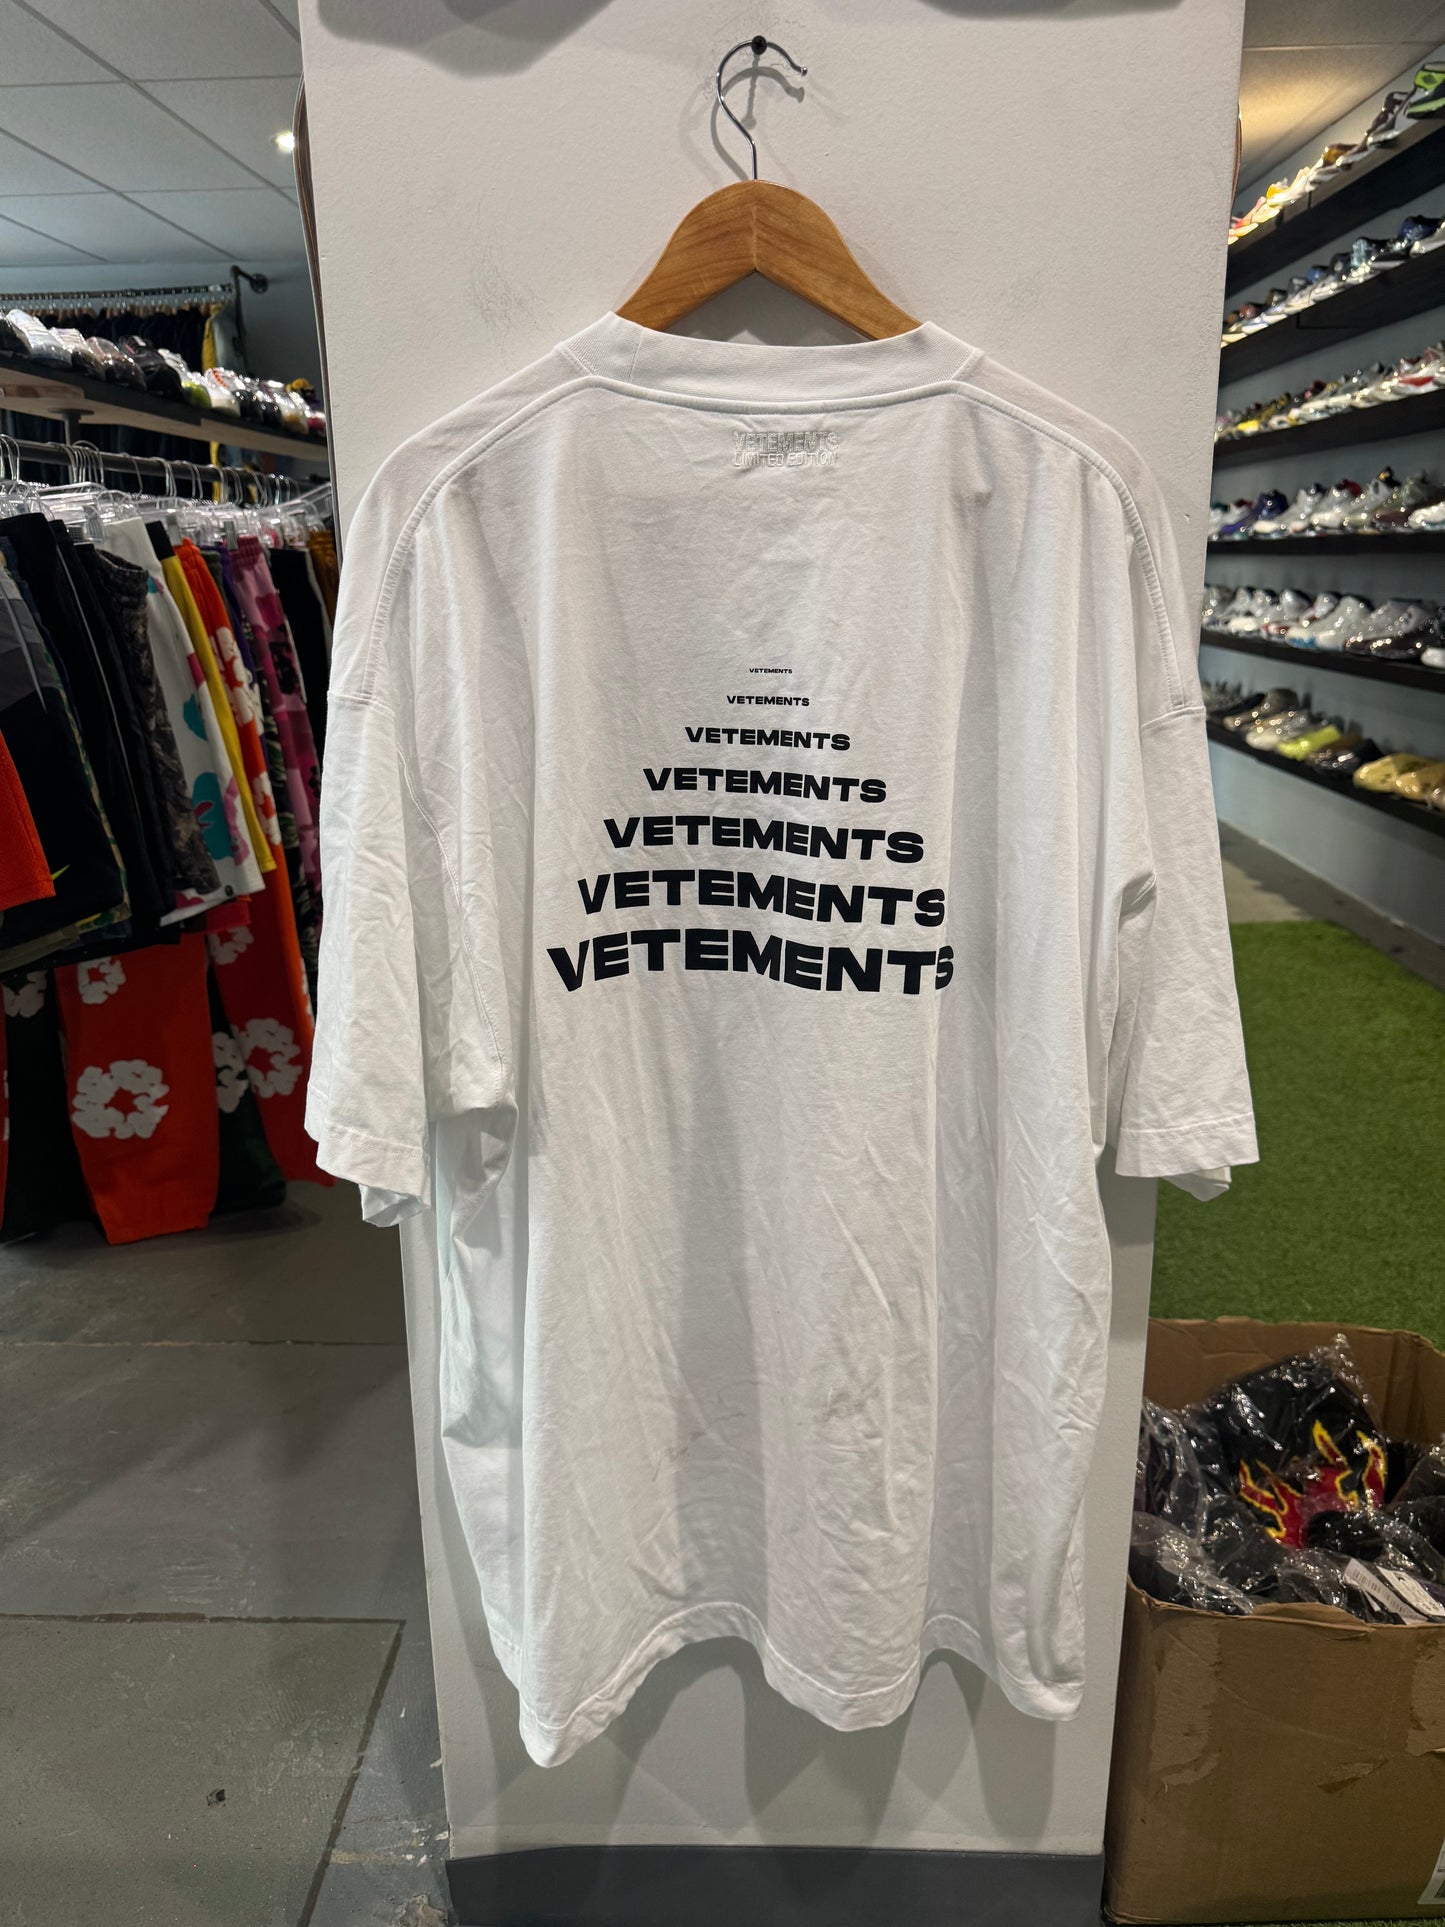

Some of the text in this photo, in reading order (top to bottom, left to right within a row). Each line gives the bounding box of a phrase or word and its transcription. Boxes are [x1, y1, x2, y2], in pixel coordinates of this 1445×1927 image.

[726, 695, 810, 707] VETEMENTS
[684, 726, 851, 751] VETEMENTS
[642, 767, 887, 804] VETEMENTS
[603, 815, 924, 864] VETEMENTS
[577, 868, 946, 928] VETEMENTS
[546, 927, 955, 995] VETEMENTS
